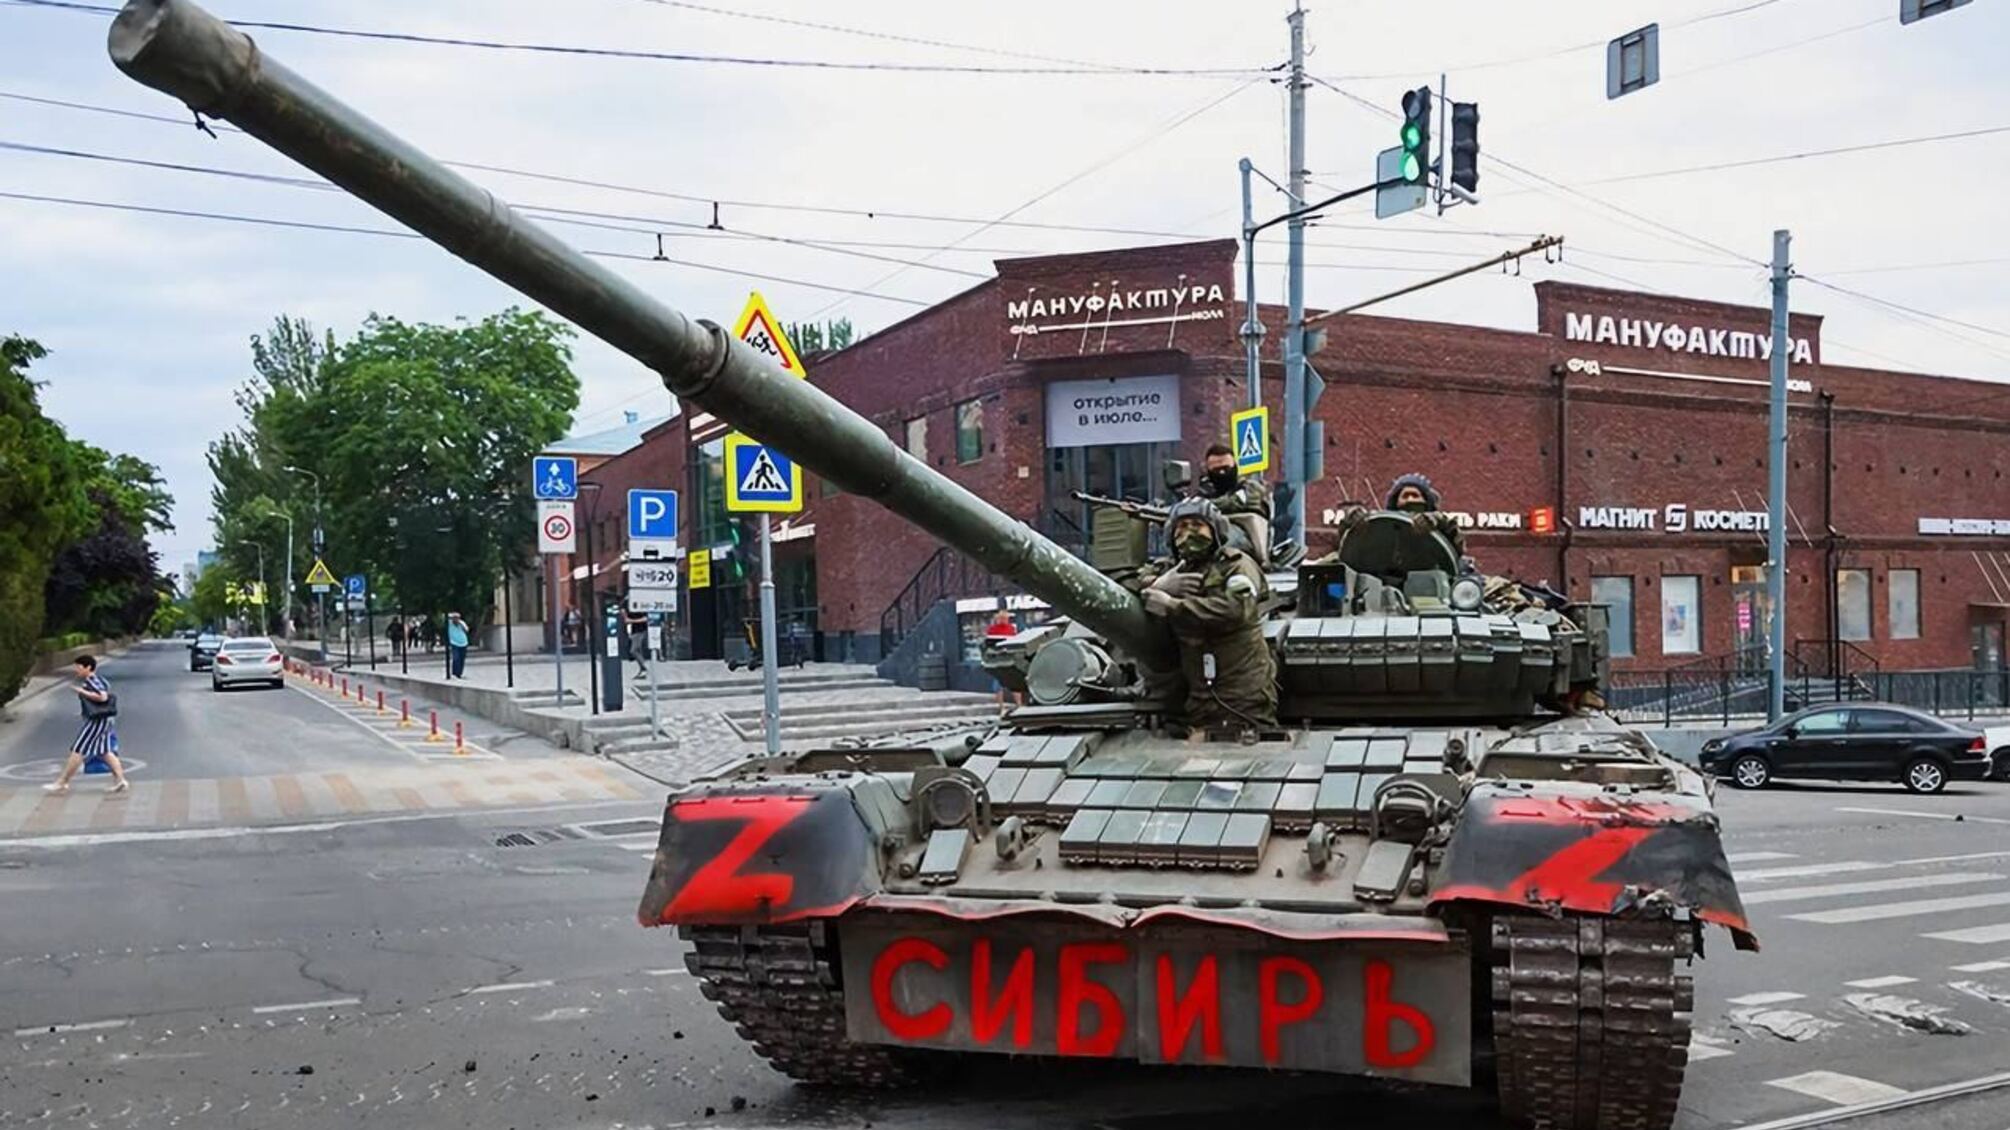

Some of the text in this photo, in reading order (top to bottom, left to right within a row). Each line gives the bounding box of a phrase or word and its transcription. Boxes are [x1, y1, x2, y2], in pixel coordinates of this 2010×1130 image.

[1007, 284, 1224, 319] МАНУФАКТУРА
[1073, 393, 1160, 410] открытие
[640, 496, 666, 532] P
[1477, 512, 1521, 528] РАКИ
[1579, 506, 1657, 530] МАГНИТ
[869, 935, 1437, 1070] СИБИРЬ
